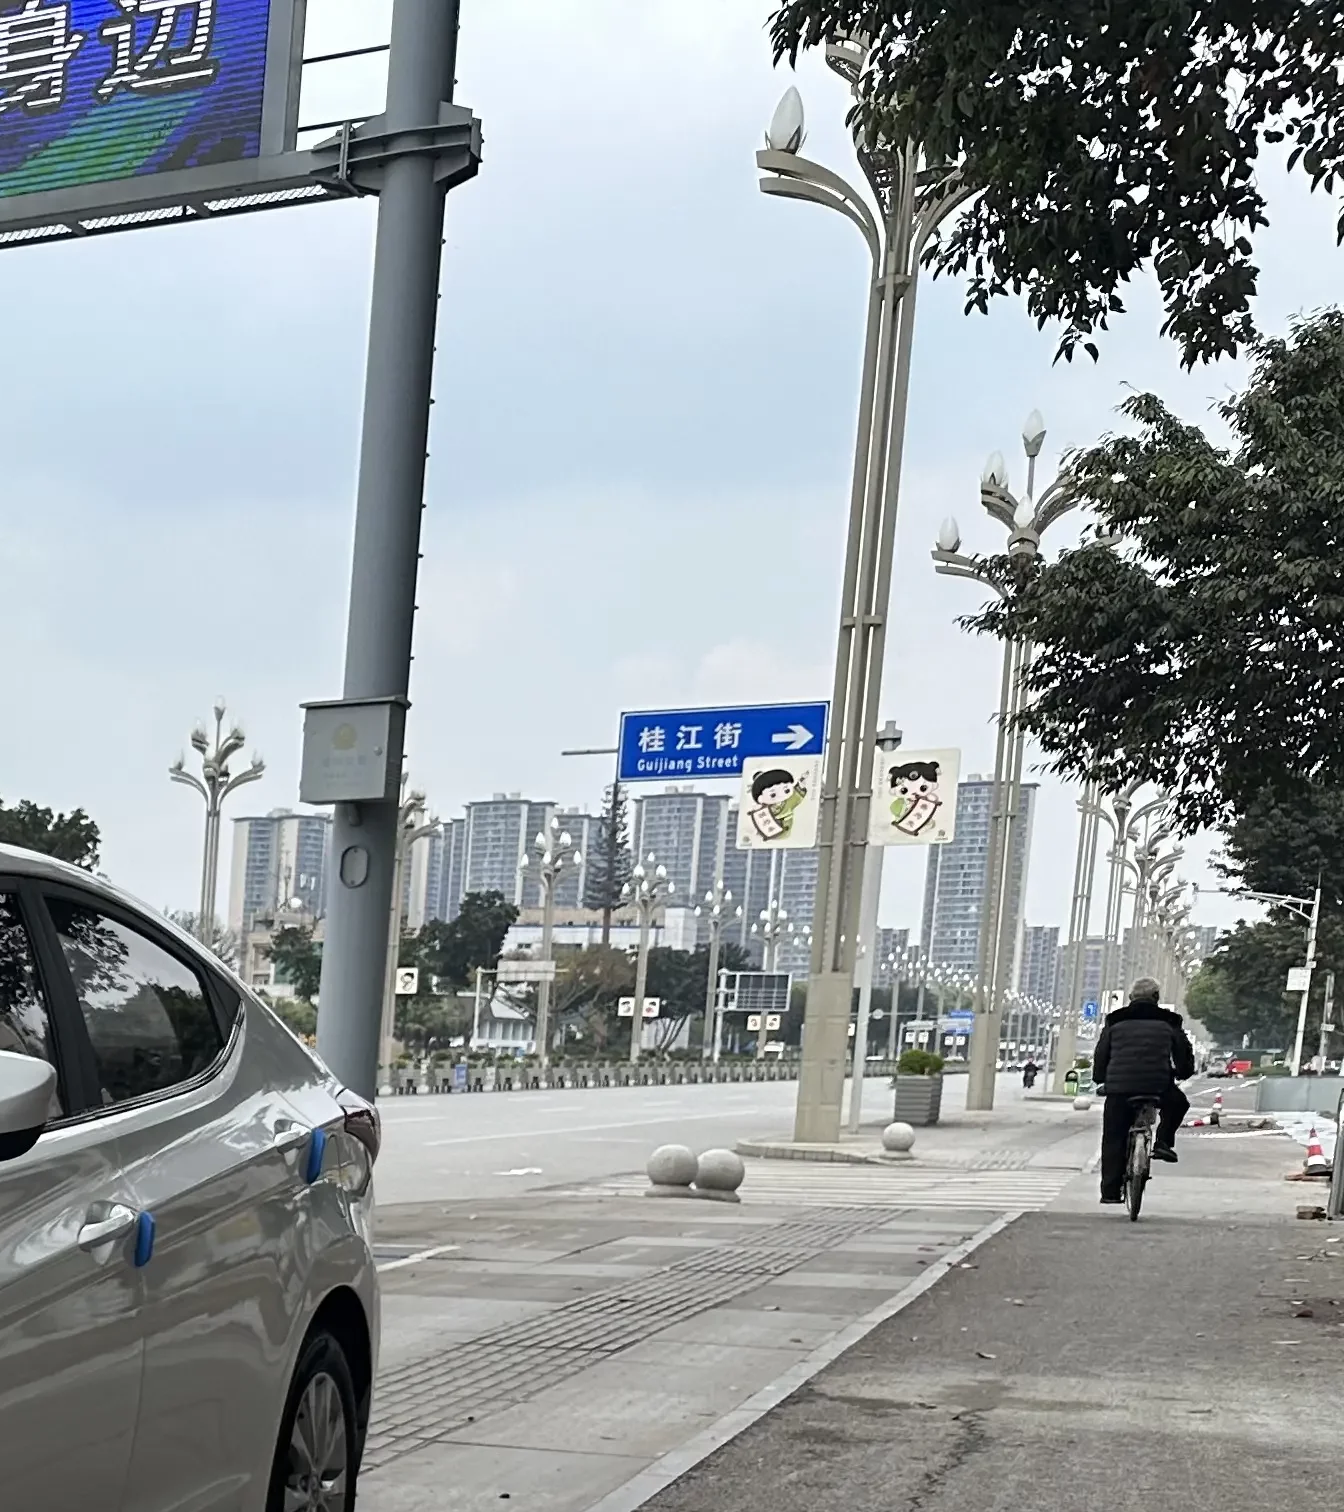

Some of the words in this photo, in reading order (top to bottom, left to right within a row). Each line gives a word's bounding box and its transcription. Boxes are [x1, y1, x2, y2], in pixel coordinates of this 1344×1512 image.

[638, 722, 743, 754] 桂江街
[637, 757, 692, 774] Guijiang
[697, 754, 738, 769] Street
